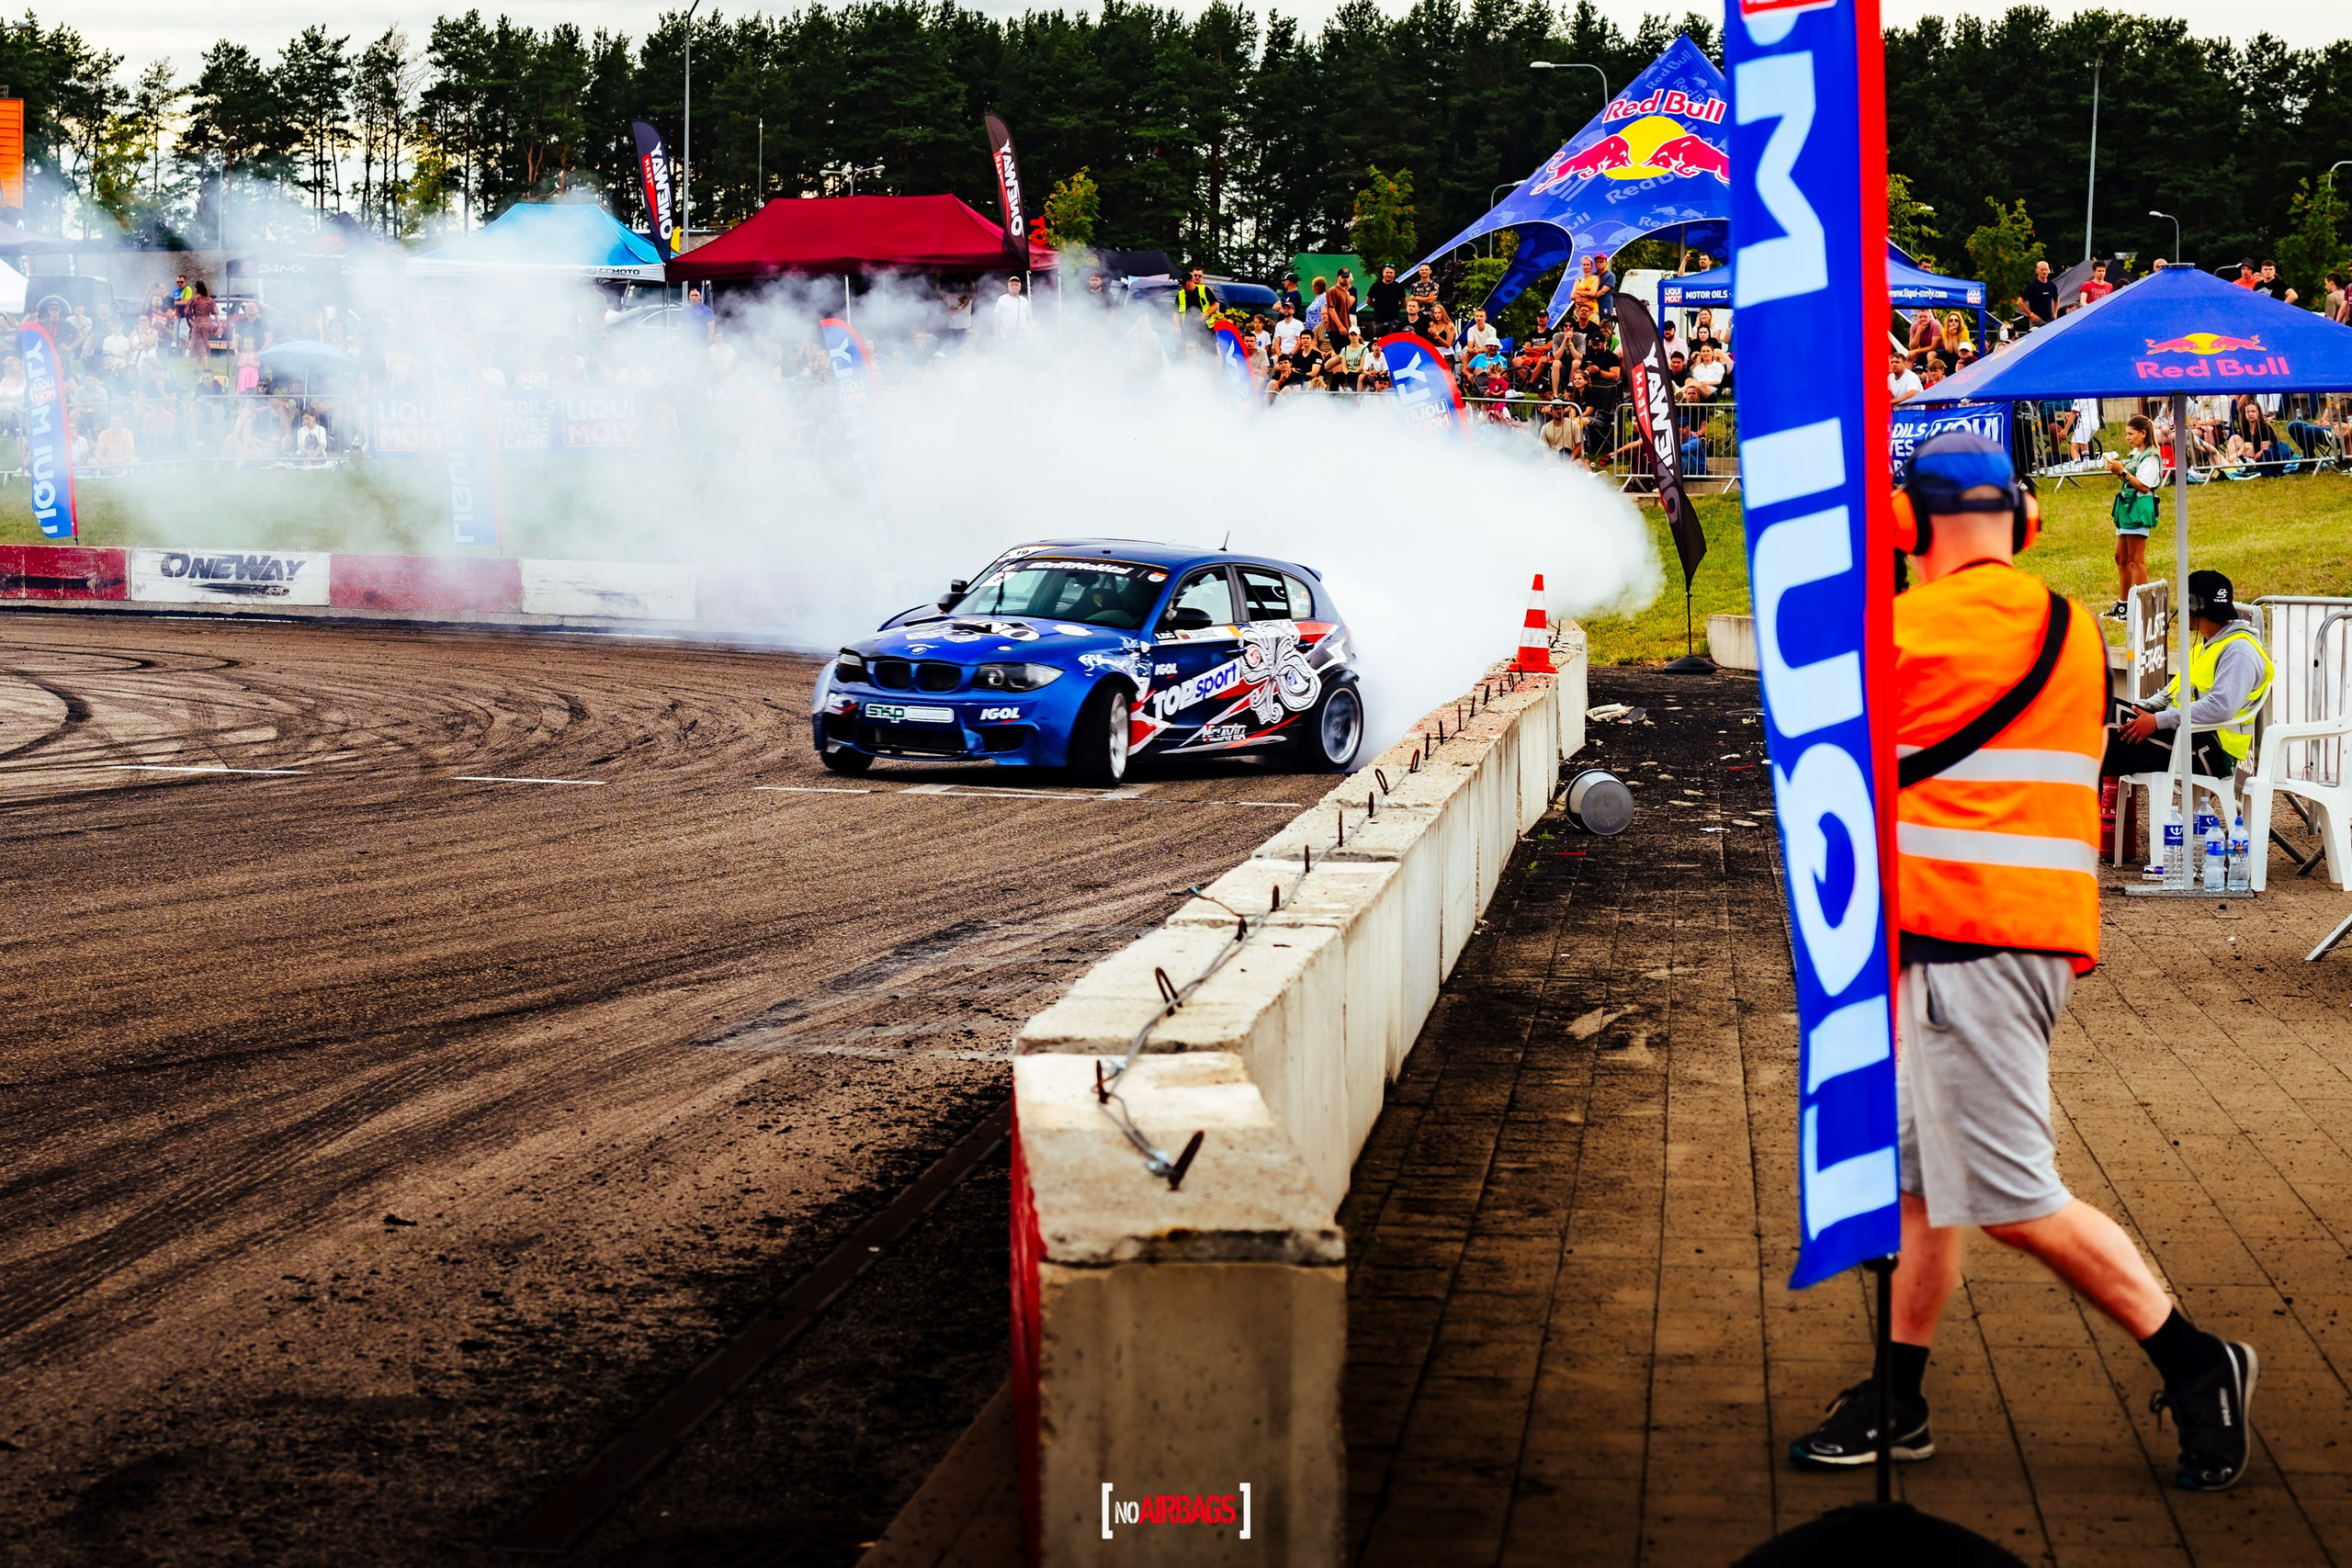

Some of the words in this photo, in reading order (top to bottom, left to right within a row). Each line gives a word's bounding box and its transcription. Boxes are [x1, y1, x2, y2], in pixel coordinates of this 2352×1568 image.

[1645, 68, 1670, 89] Red
[1666, 50, 1693, 70] Bull
[1601, 88, 1665, 124] Red
[1661, 89, 1727, 125] Bull
[1665, 288, 1682, 296] LIQUI
[1665, 295, 1682, 303] MOLY
[1686, 291, 1711, 299] MOTOR
[1712, 290, 1728, 299] OILS
[2135, 359, 2211, 378] Red
[2216, 356, 2290, 377] Bull
[379, 402, 437, 423] LIQU
[519, 400, 556, 413] OILS
[567, 397, 636, 421] LIQUI
[568, 422, 638, 444] MOLY
[1892, 423, 1928, 438] OILS
[504, 434, 550, 449] CARE
[1155, 663, 1178, 675] IGOL
[980, 707, 1020, 720] IGOL
